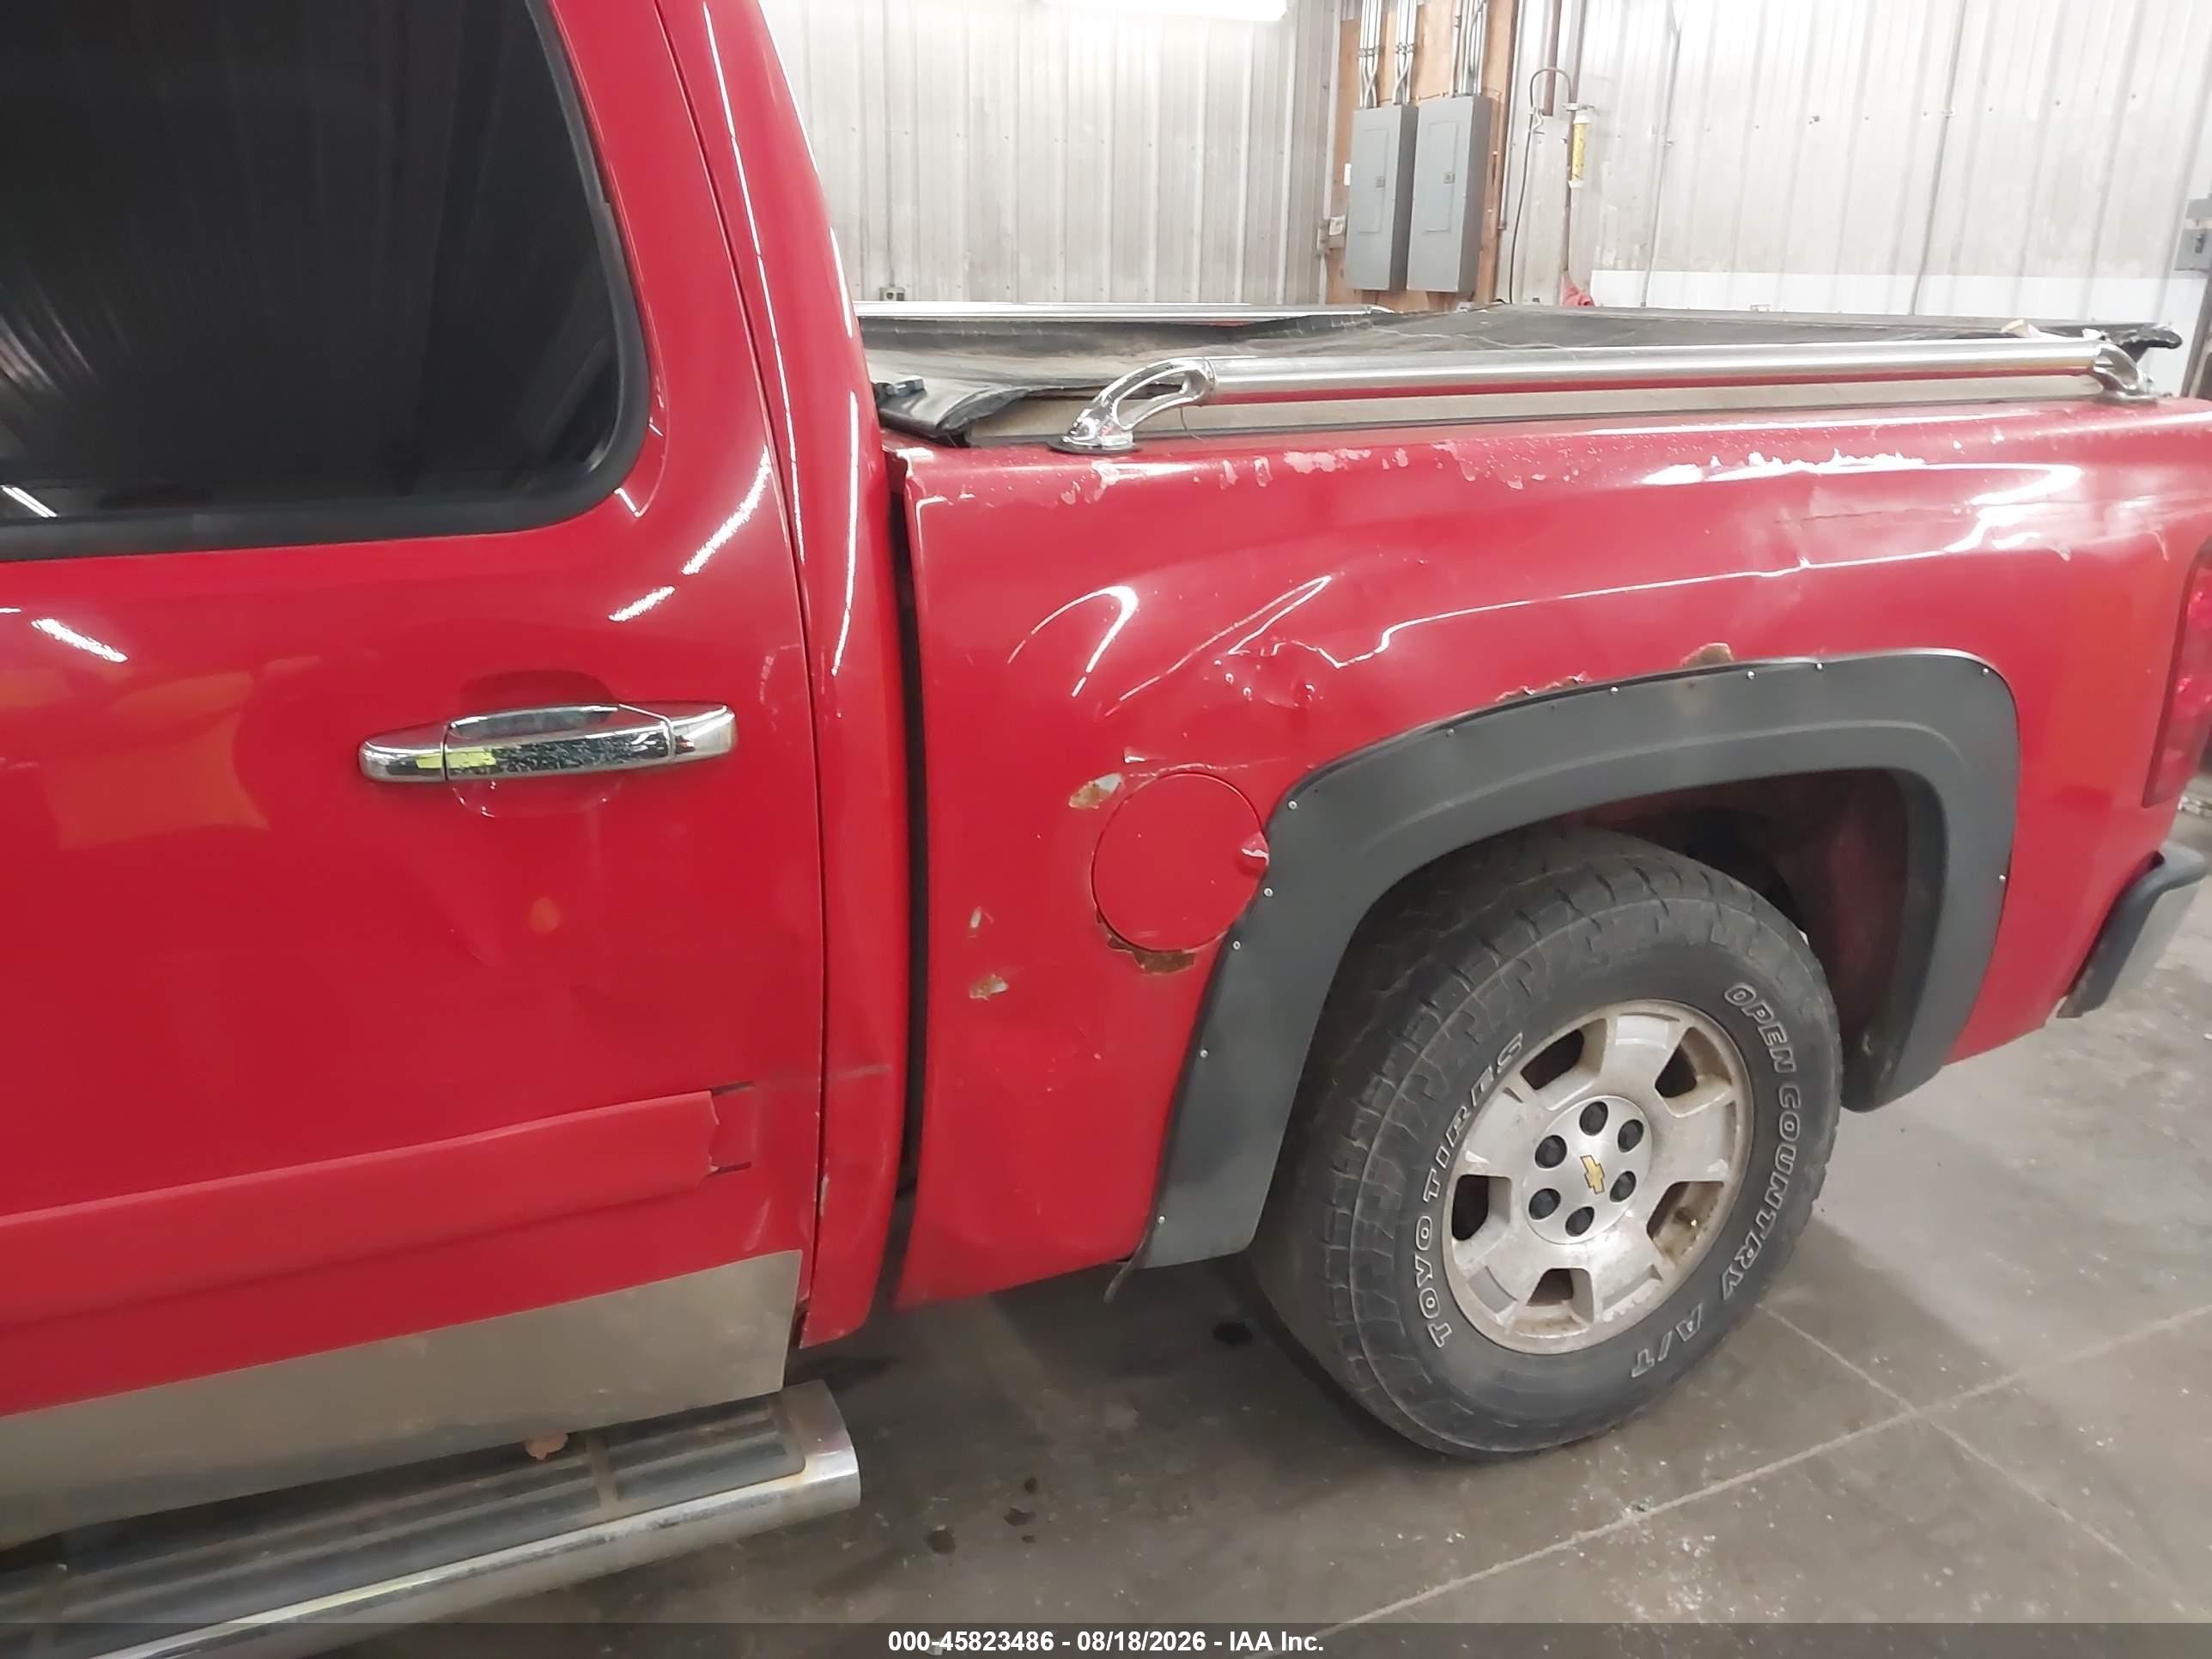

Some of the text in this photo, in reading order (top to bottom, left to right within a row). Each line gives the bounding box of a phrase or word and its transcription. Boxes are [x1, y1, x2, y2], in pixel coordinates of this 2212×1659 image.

[1414, 1215, 1453, 1348] TOYO
[1632, 982, 1802, 1377] OPEN COUNTRY A/T
